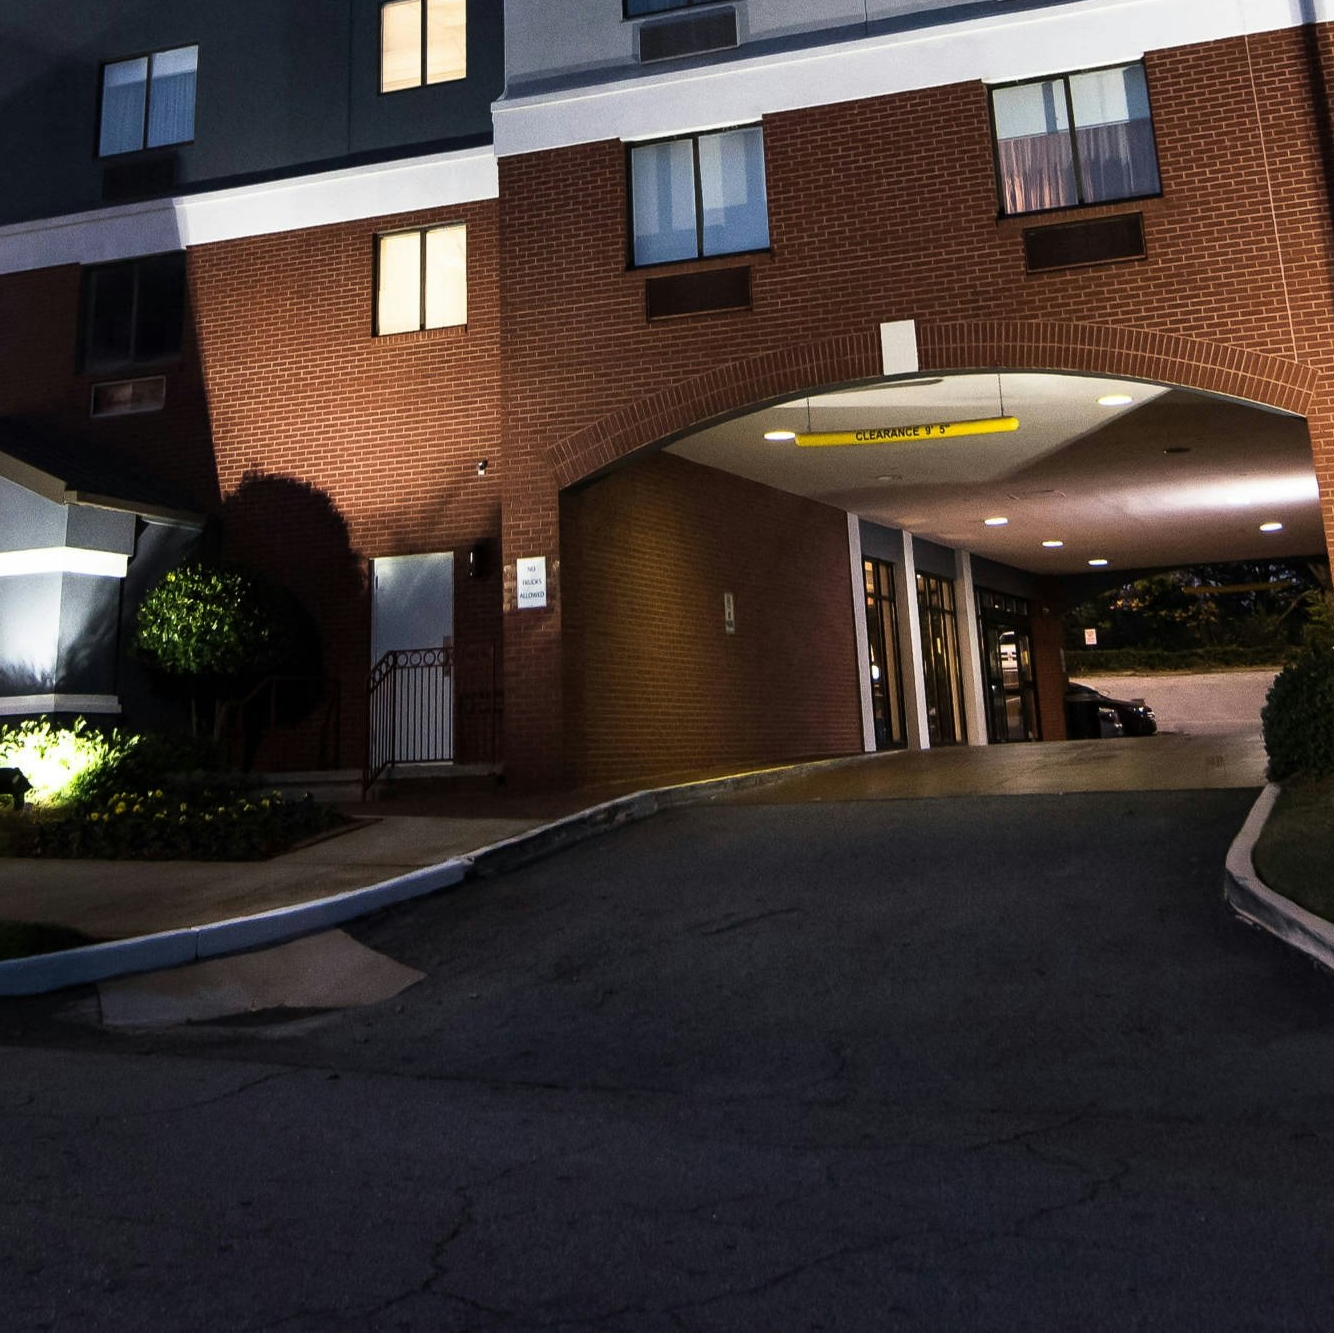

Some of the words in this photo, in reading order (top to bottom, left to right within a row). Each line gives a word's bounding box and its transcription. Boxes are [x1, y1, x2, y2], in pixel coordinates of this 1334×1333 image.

[855, 426, 919, 441] CLEARANCE
[522, 578, 542, 586] TRUCKS
[520, 591, 545, 599] ALLOWED
